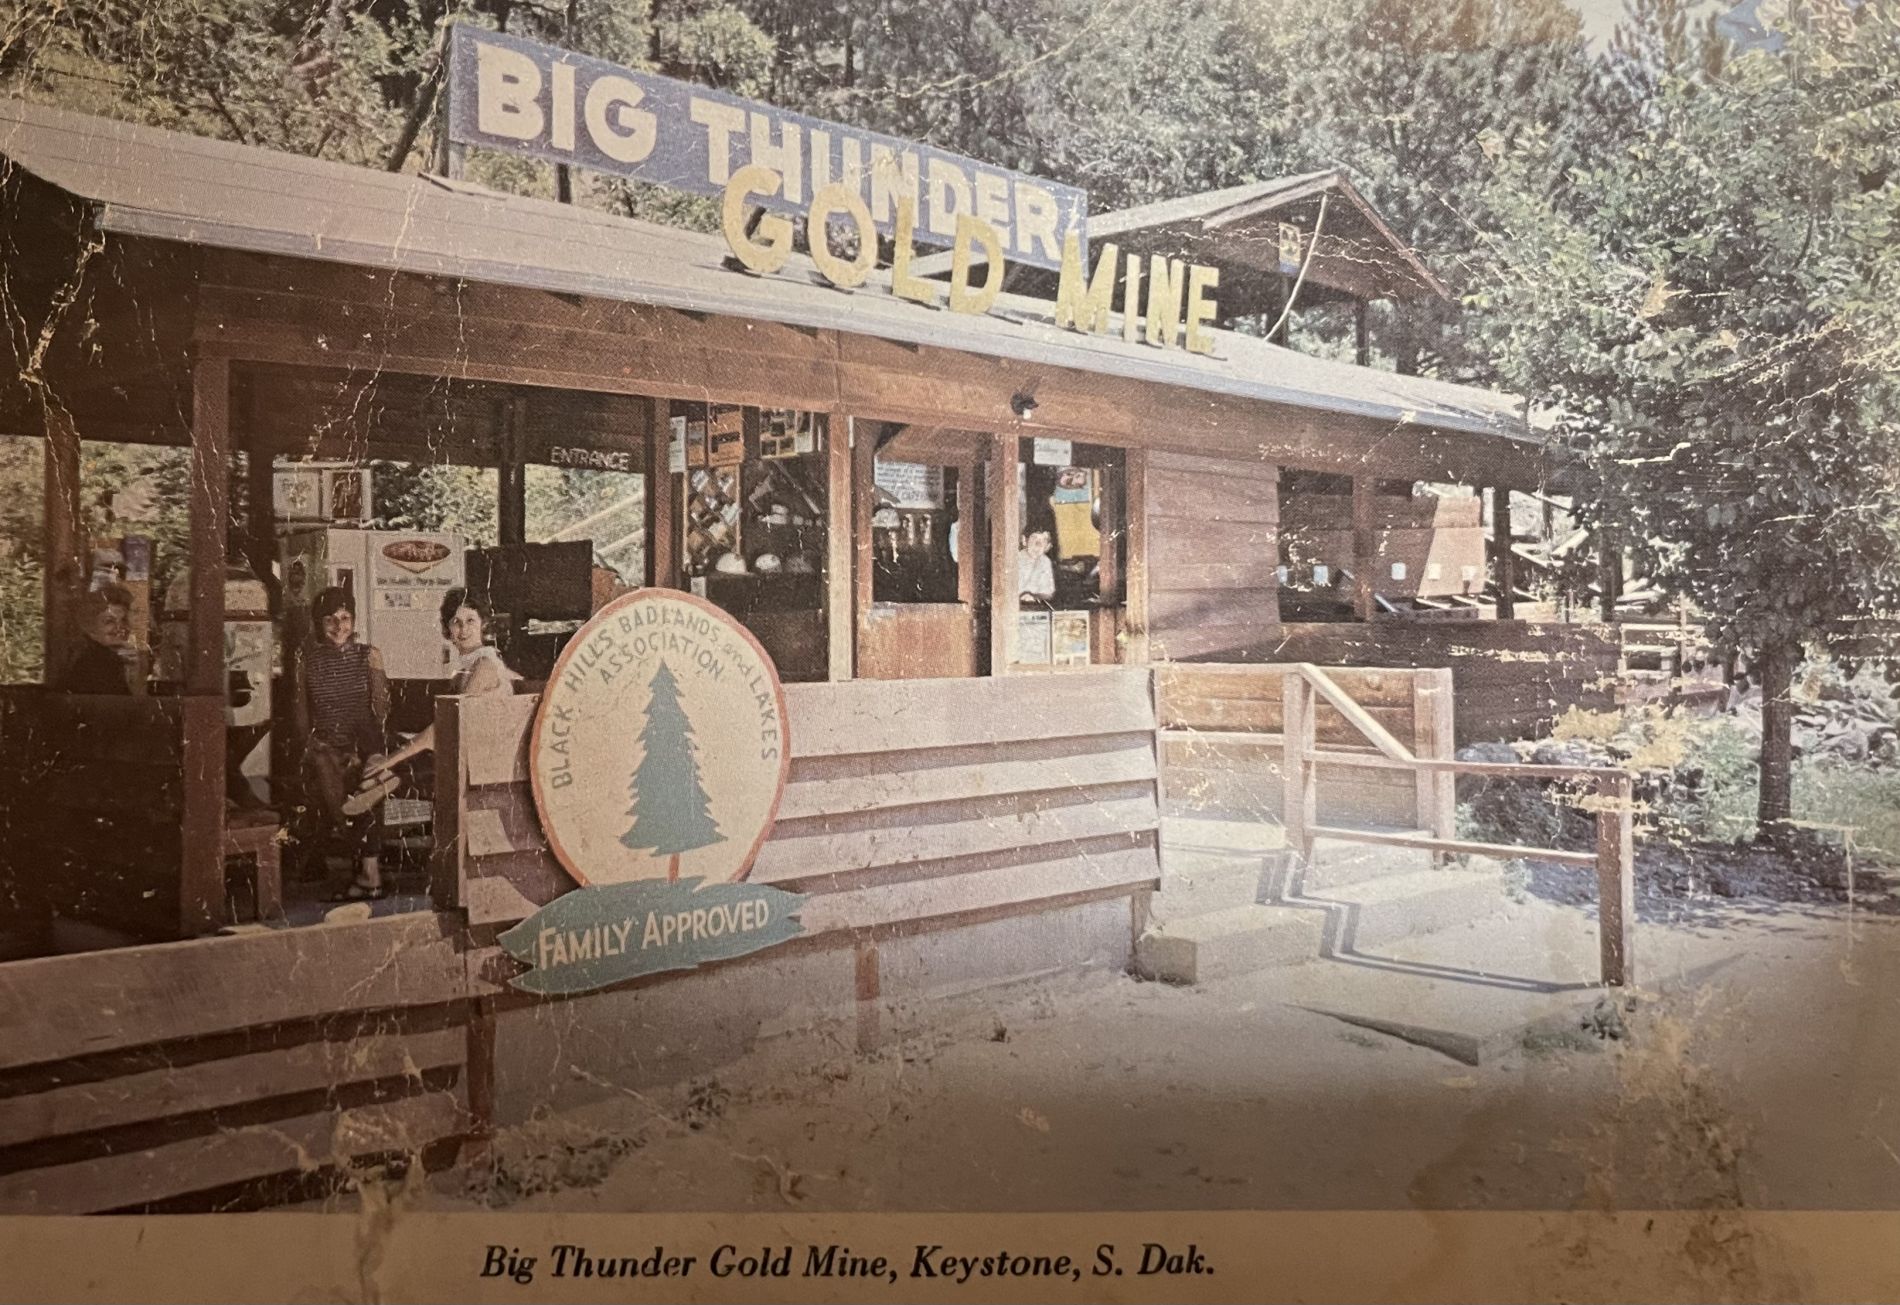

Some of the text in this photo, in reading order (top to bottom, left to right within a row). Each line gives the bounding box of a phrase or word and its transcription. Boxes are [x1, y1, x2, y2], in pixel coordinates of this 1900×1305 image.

[476, 43, 1062, 262] BIG THUNDER
[723, 165, 1220, 354] GOLD MINE
[551, 446, 630, 471] ENTRANCE
[551, 705, 573, 789] BLACK
[618, 606, 721, 643] BADLANDS
[722, 642, 751, 679] and
[749, 675, 778, 761] LAKES
[600, 631, 725, 685] ASSOCIATION
[539, 898, 770, 970] FAMILY APPROVED
